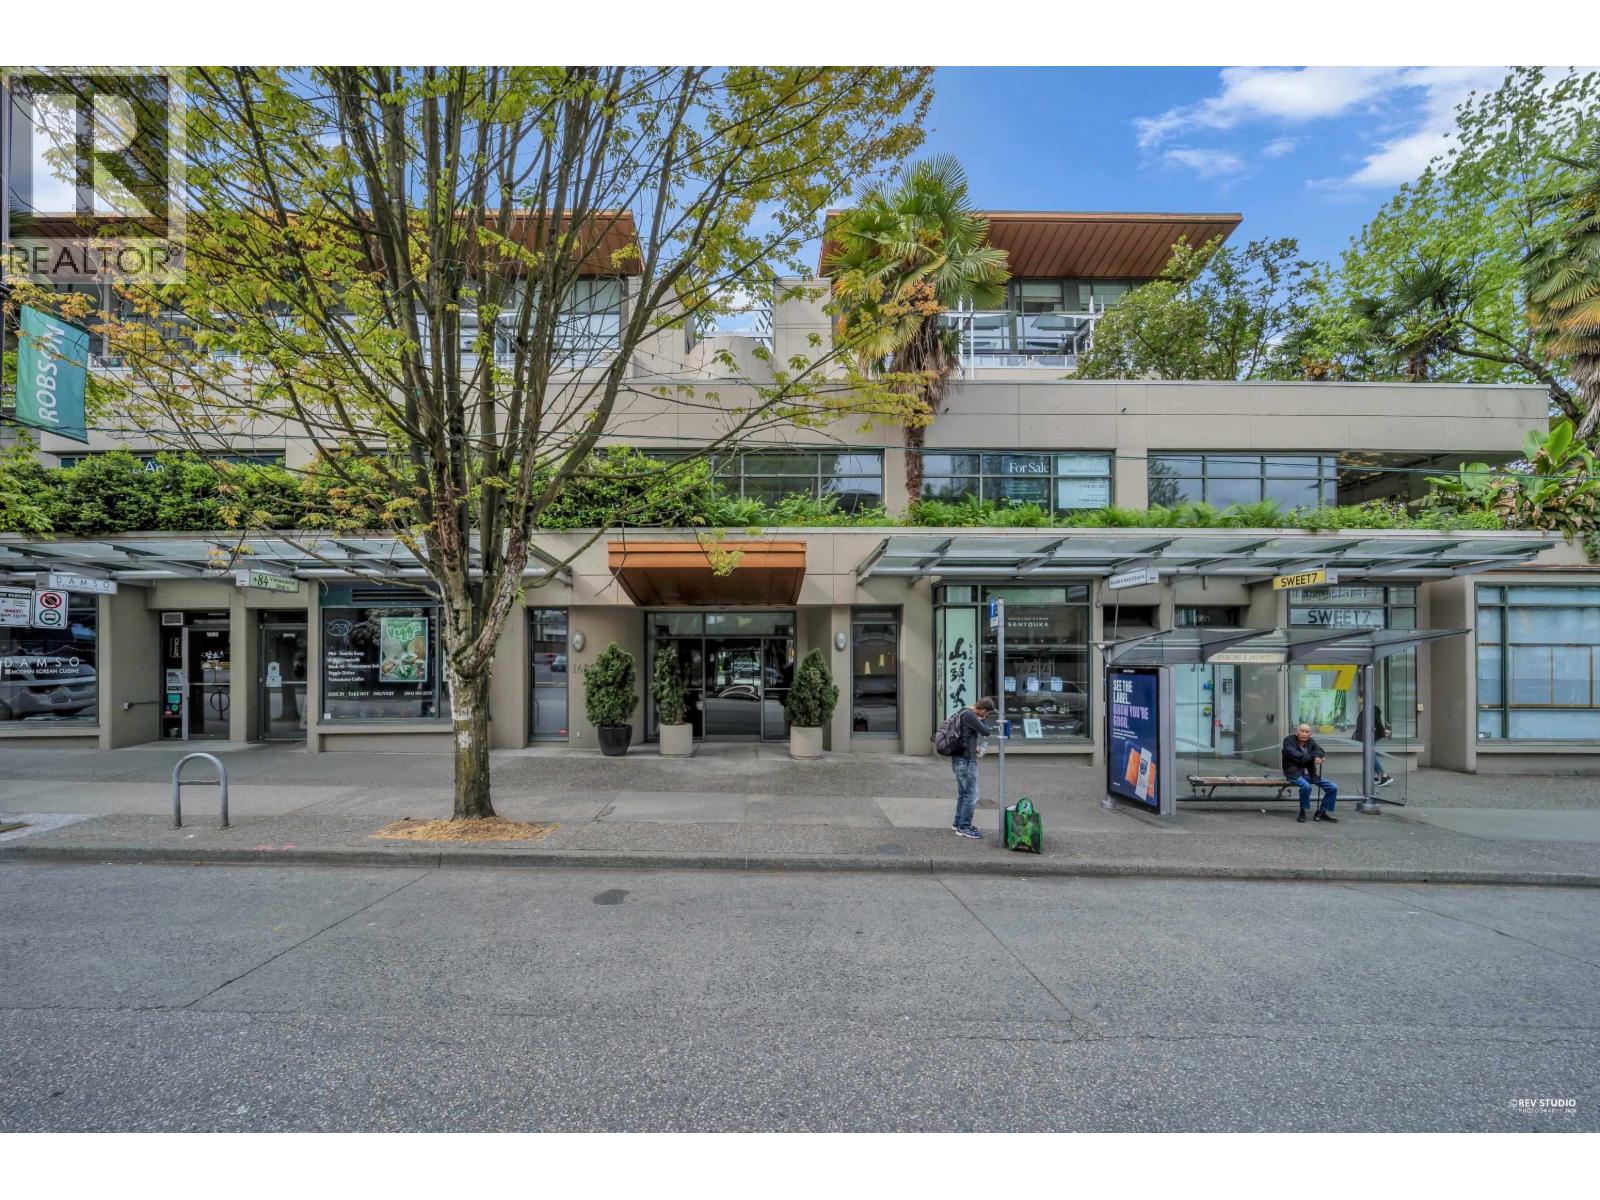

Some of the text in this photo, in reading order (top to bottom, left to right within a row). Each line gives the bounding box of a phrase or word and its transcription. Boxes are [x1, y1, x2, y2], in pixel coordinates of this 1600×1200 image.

[36, 324, 65, 424] ROBSON
[1009, 462, 1049, 473] For Sale
[56, 575, 109, 589] DAMSO
[1280, 573, 1318, 588] SWEET7
[1308, 609, 1371, 624] SWEET7
[5, 656, 80, 668] DAMSO
[1113, 680, 1133, 693] SEE THE
[1113, 693, 1131, 705] LABEL.
[1113, 704, 1149, 720] KNOW YOU'RE
